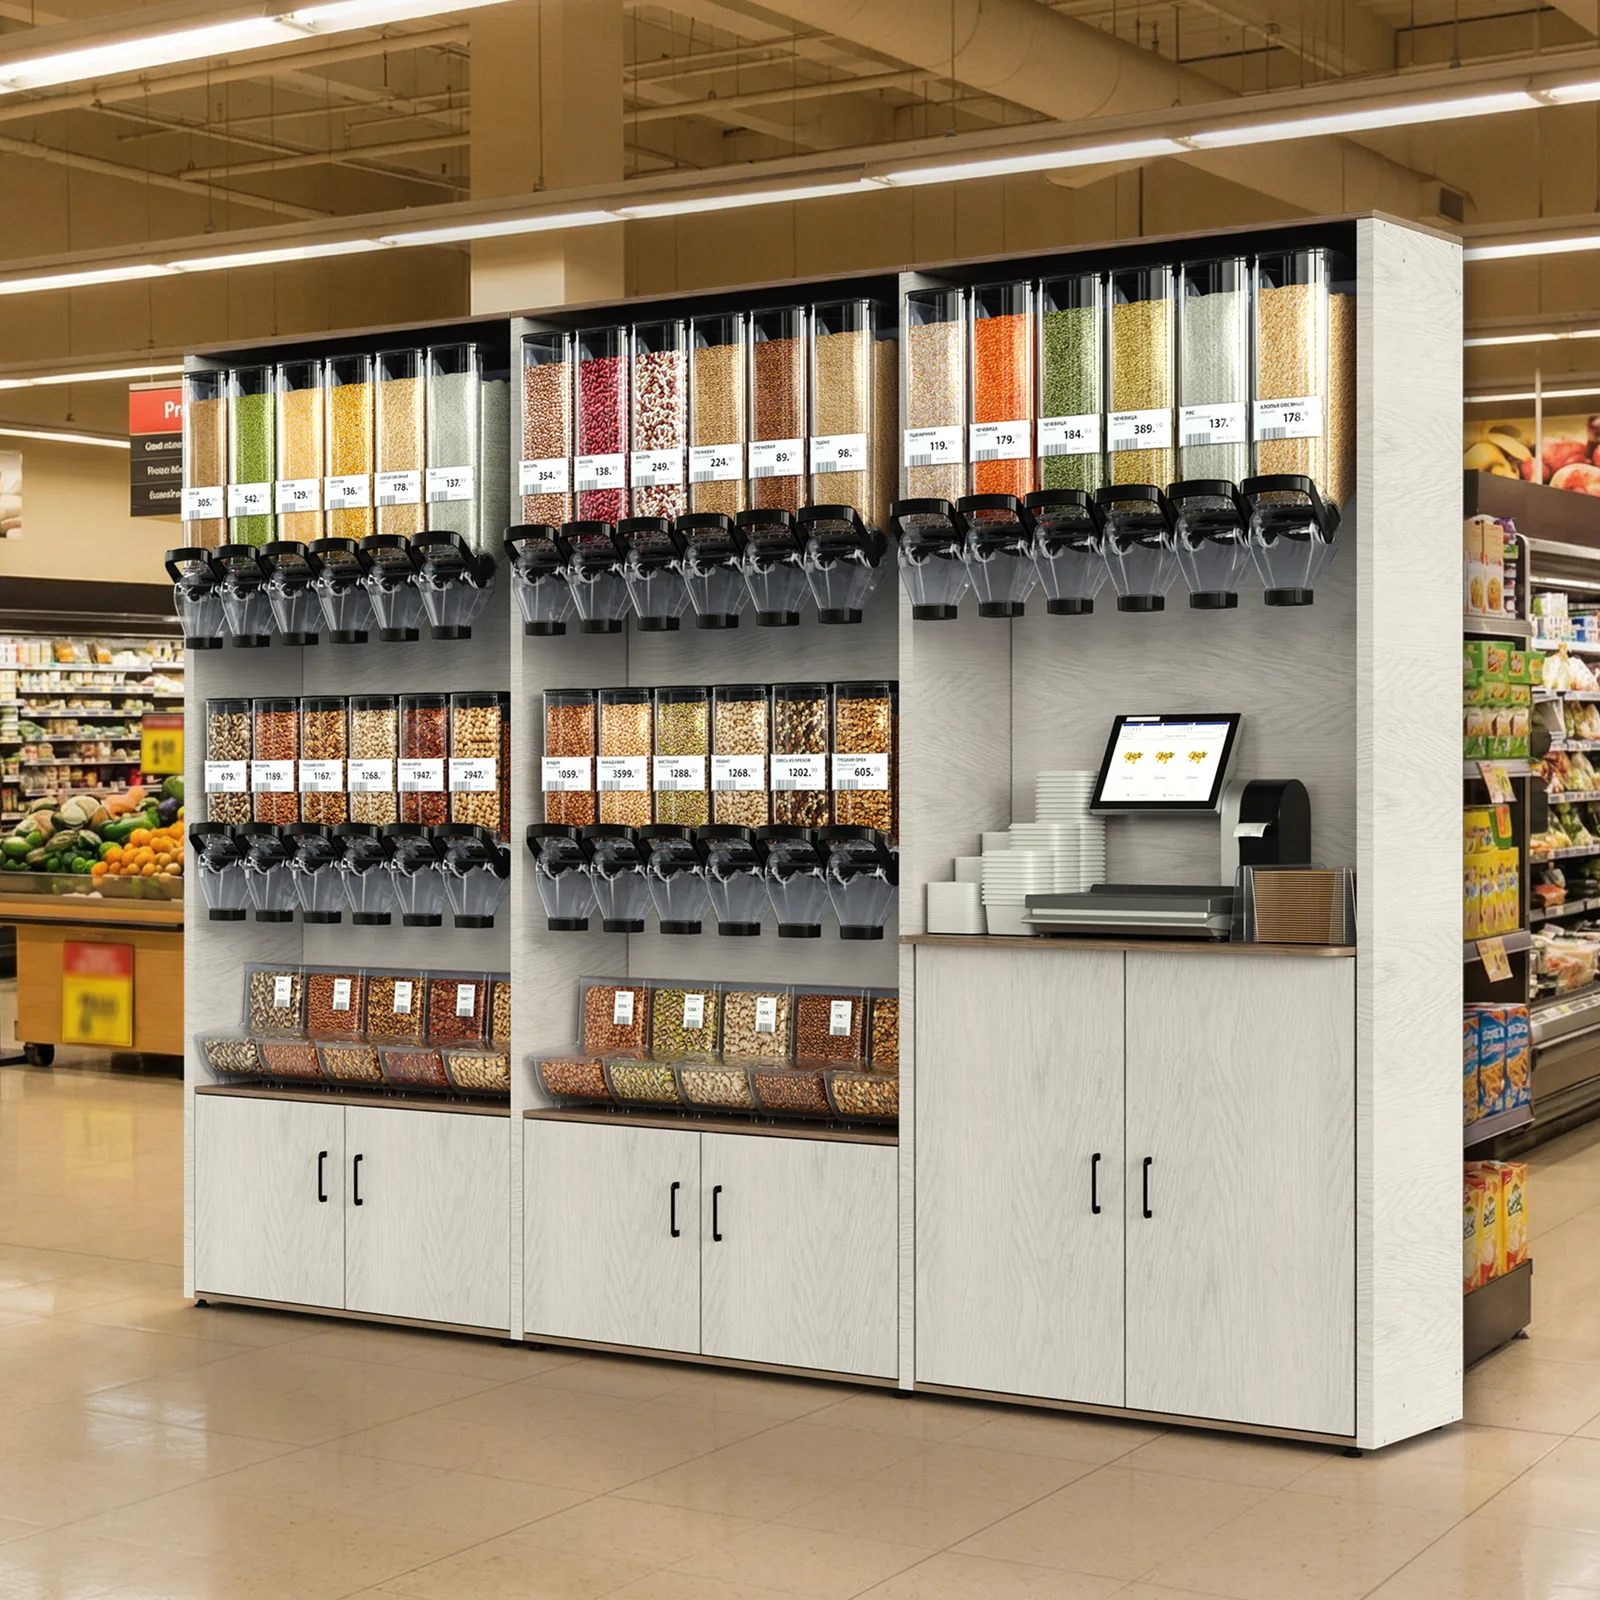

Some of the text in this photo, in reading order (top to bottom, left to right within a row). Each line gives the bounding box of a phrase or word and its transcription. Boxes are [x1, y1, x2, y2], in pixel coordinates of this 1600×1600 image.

[1283, 412, 1304, 423] 178.
[1209, 418, 1228, 428] 137.
[1134, 424, 1155, 434] 389.
[1064, 430, 1084, 440] 184.
[996, 435, 1015, 445] 179.
[930, 441, 947, 450] 119.
[776, 453, 789, 462] 89.
[838, 448, 852, 458] 98.
[652, 463, 669, 471] 249.
[711, 458, 728, 467] 224.
[539, 472, 555, 480] 354.
[596, 467, 611, 476] 138.
[394, 483, 408, 491] 178.
[446, 479, 460, 487] 137.
[294, 491, 308, 499] 129.
[343, 487, 357, 496] 136.
[197, 498, 212, 507] 305.
[244, 494, 259, 503] 542.
[265, 772, 282, 780] 1189.
[314, 772, 331, 780] 1167.
[362, 771, 380, 780] 1268.
[413, 771, 431, 779] 1947.
[464, 771, 483, 779] 2947.
[558, 770, 578, 779] 1059.
[613, 769, 634, 778] 3599.
[670, 769, 692, 778] 1288.
[729, 768, 750, 778] 1268.
[789, 768, 811, 777] 1202.
[854, 767, 873, 777] 605.
